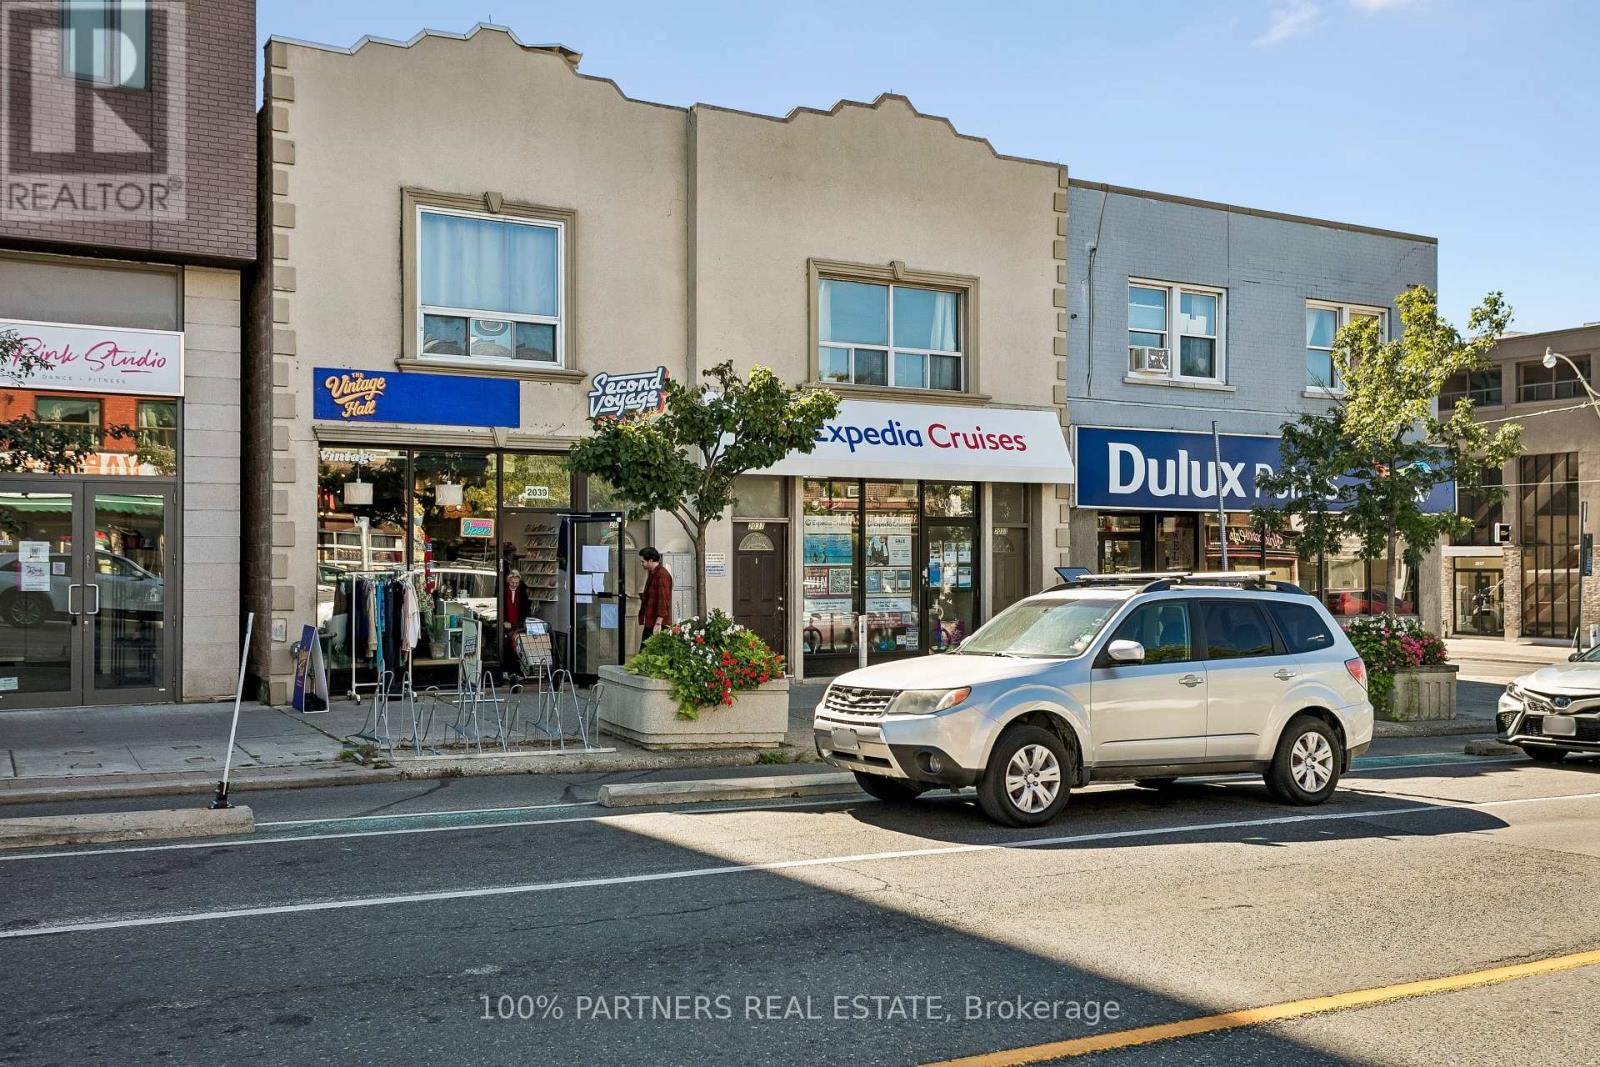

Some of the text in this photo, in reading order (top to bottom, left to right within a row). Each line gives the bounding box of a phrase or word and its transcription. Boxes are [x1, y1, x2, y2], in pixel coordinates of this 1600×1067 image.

[85, 341, 167, 373] Studio
[42, 374, 127, 385] DANCE FITNESS
[325, 375, 386, 400] Vintage
[588, 367, 663, 397] Second
[342, 400, 376, 418] Hall
[590, 390, 658, 418] Voyage
[927, 423, 1027, 452] Cruises
[1107, 442, 1247, 498] Dulux
[527, 488, 548, 497] 2039
